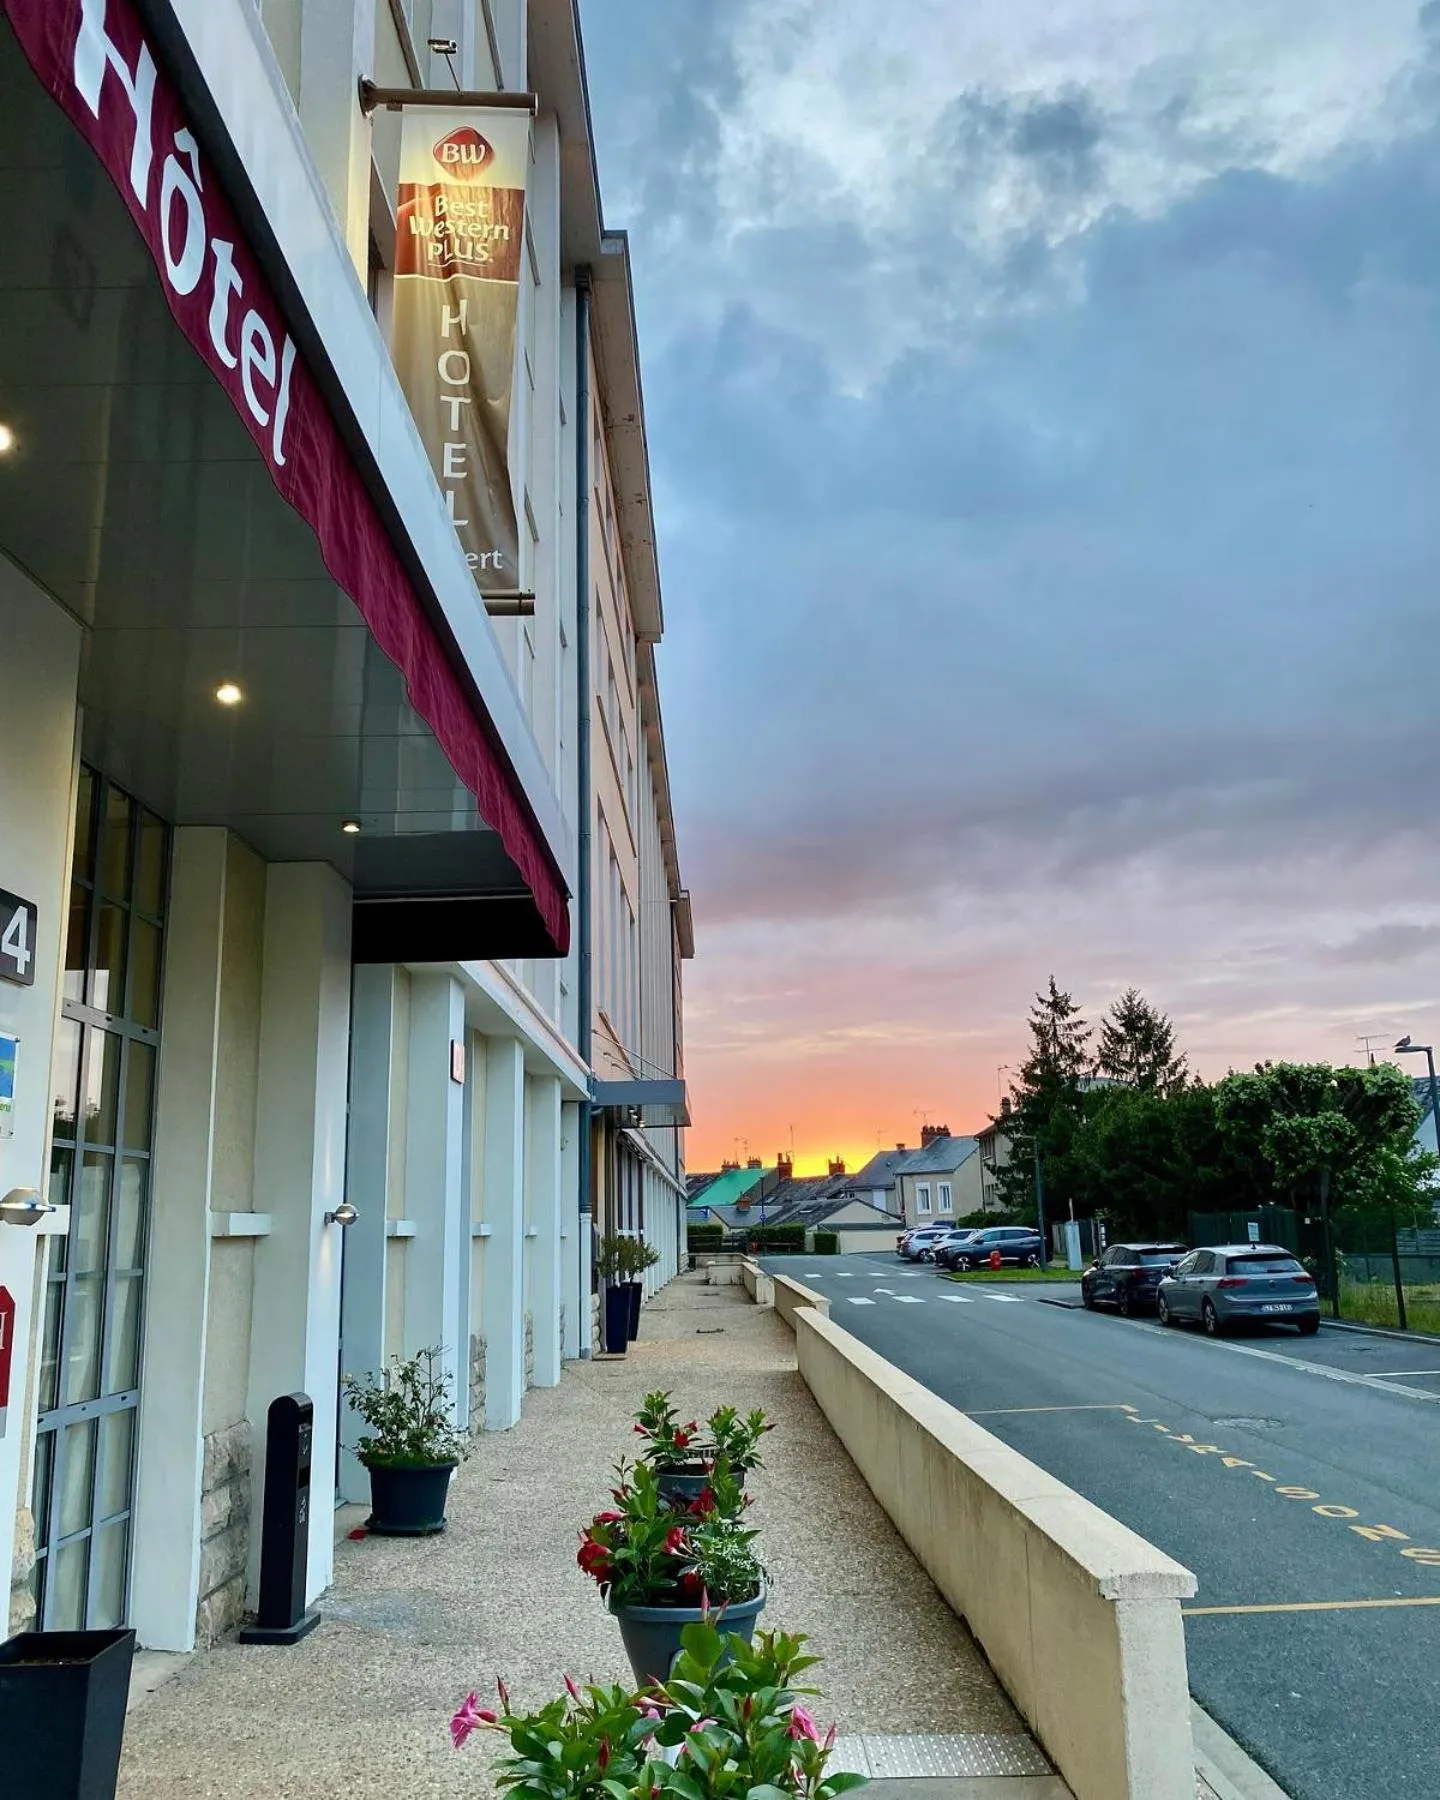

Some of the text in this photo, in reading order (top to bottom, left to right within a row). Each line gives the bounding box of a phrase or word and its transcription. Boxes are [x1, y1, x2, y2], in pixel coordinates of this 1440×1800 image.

[441, 142, 486, 165] BW
[435, 195, 488, 218] Best
[74, 0, 297, 467] Hôtel
[409, 215, 510, 240] Western
[437, 299, 472, 527] HOTEL
[465, 550, 503, 570] ert
[1125, 1415, 1440, 1566] LIVRAISONS
